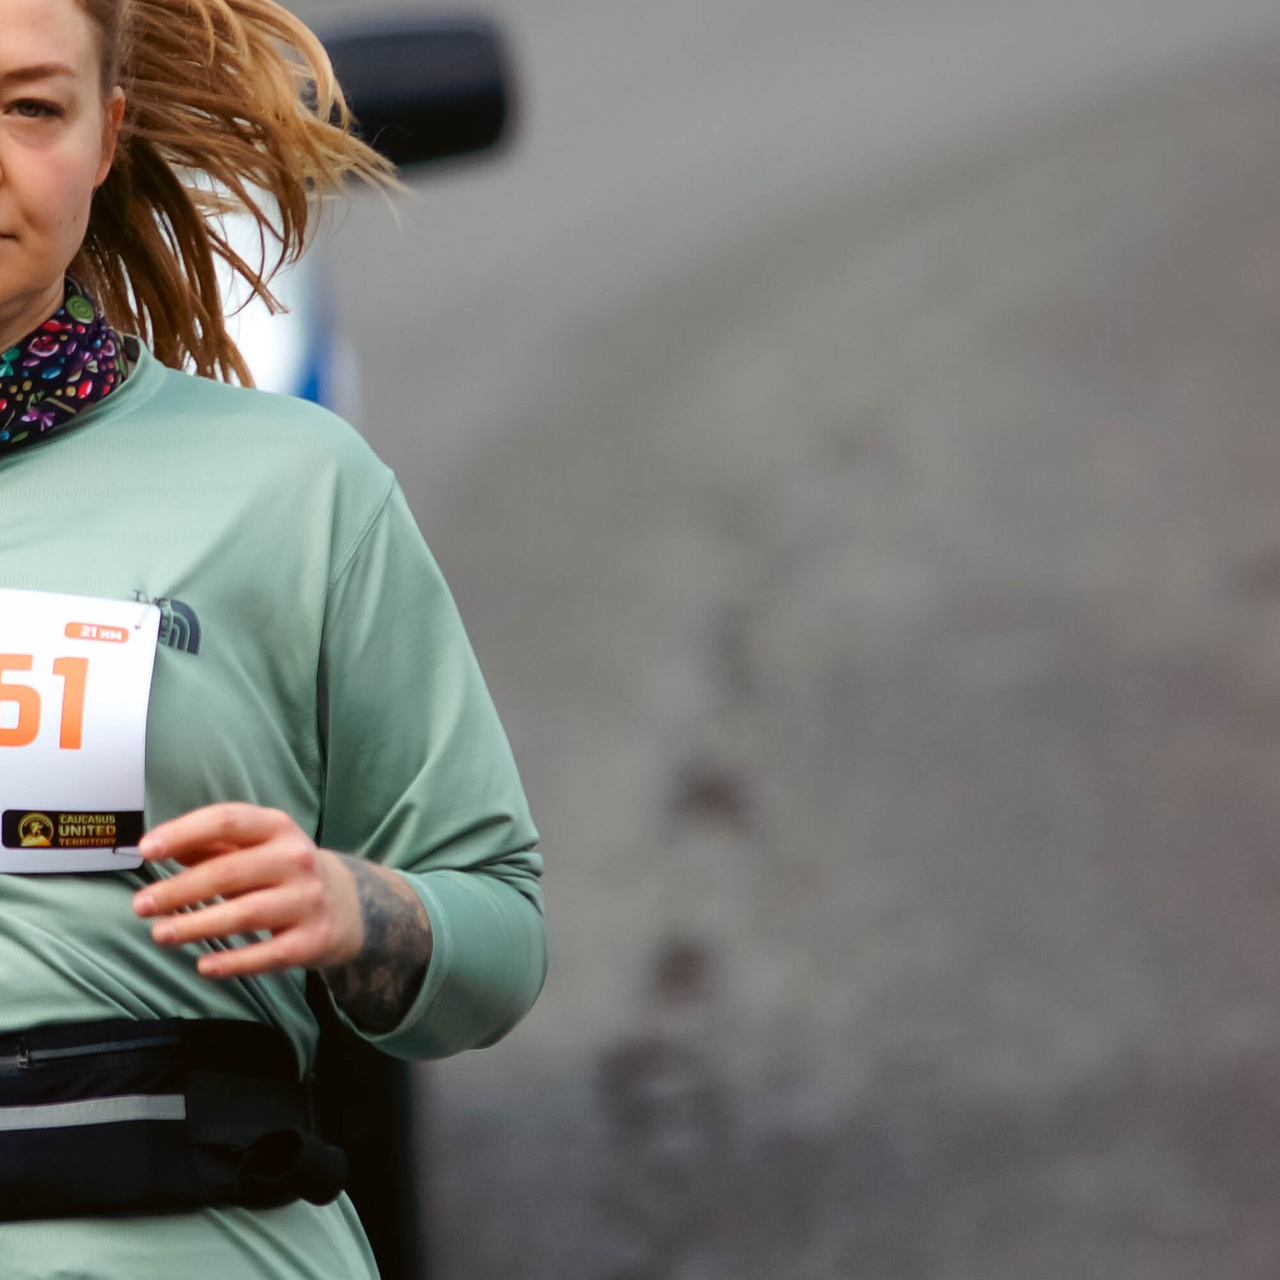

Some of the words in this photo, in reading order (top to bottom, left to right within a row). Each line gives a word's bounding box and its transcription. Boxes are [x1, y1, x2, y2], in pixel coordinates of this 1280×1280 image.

[81, 625, 97, 638] 21
[58, 814, 116, 824] CAUCASUS
[58, 824, 116, 837] UNITED
[59, 837, 116, 846] TERRITORY
